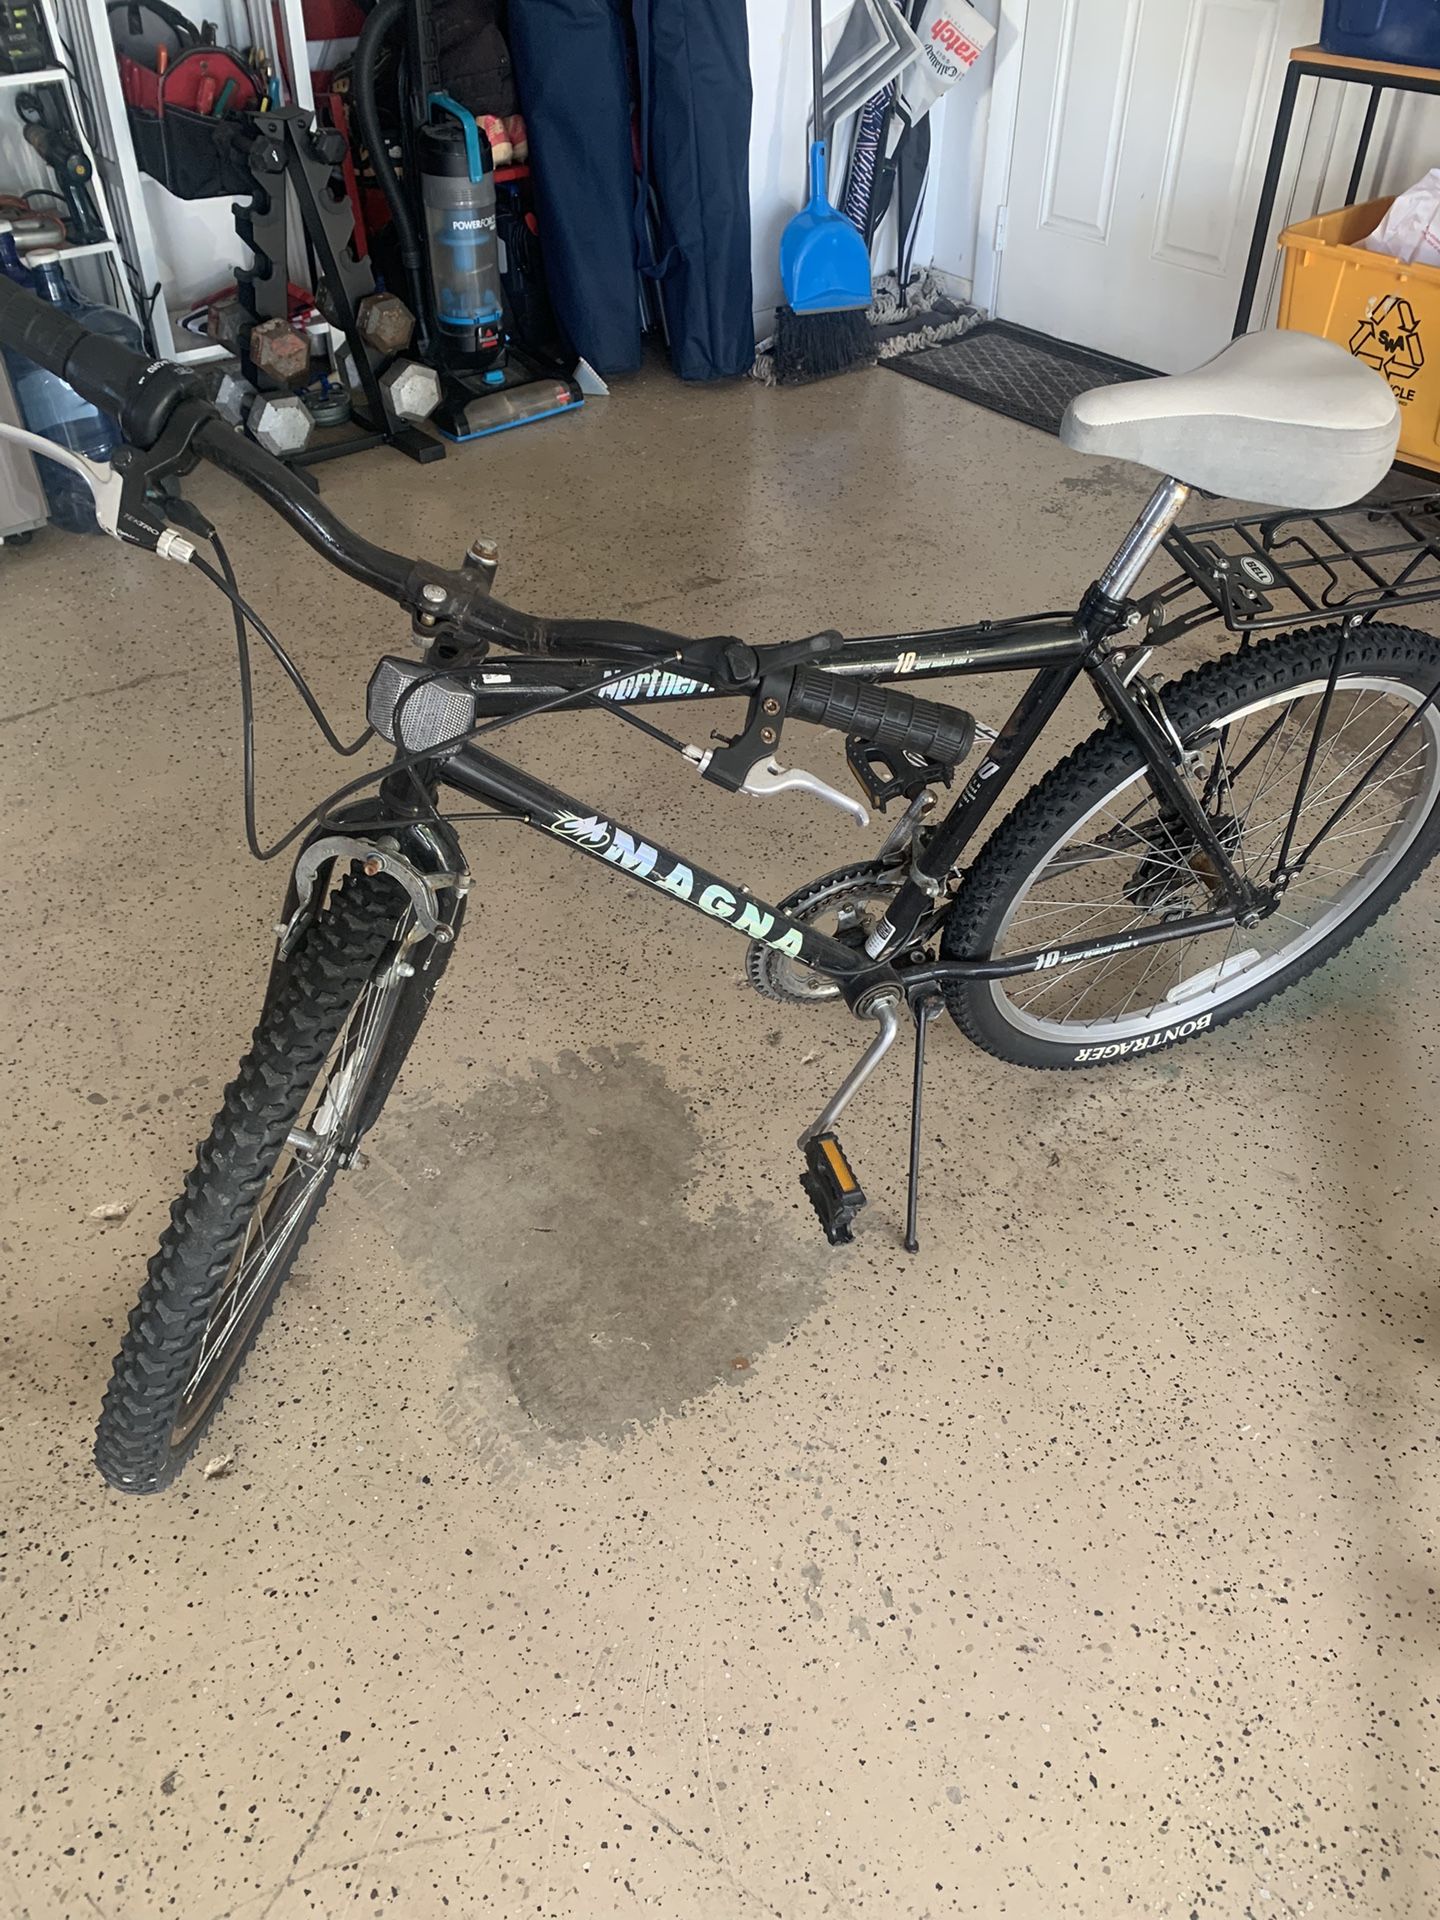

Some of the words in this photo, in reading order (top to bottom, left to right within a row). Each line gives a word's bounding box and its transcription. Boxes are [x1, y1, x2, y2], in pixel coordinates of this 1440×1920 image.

[924, 43, 958, 78] Callaway
[452, 213, 496, 231] POWERFORC
[1390, 384, 1416, 401] CLE
[1246, 561, 1268, 581] BELL
[894, 652, 917, 674] 10
[598, 668, 716, 701] Norther
[602, 827, 804, 959] MAGNA
[1034, 950, 1061, 972] 10
[1074, 1012, 1213, 1062] BONTRAGER
